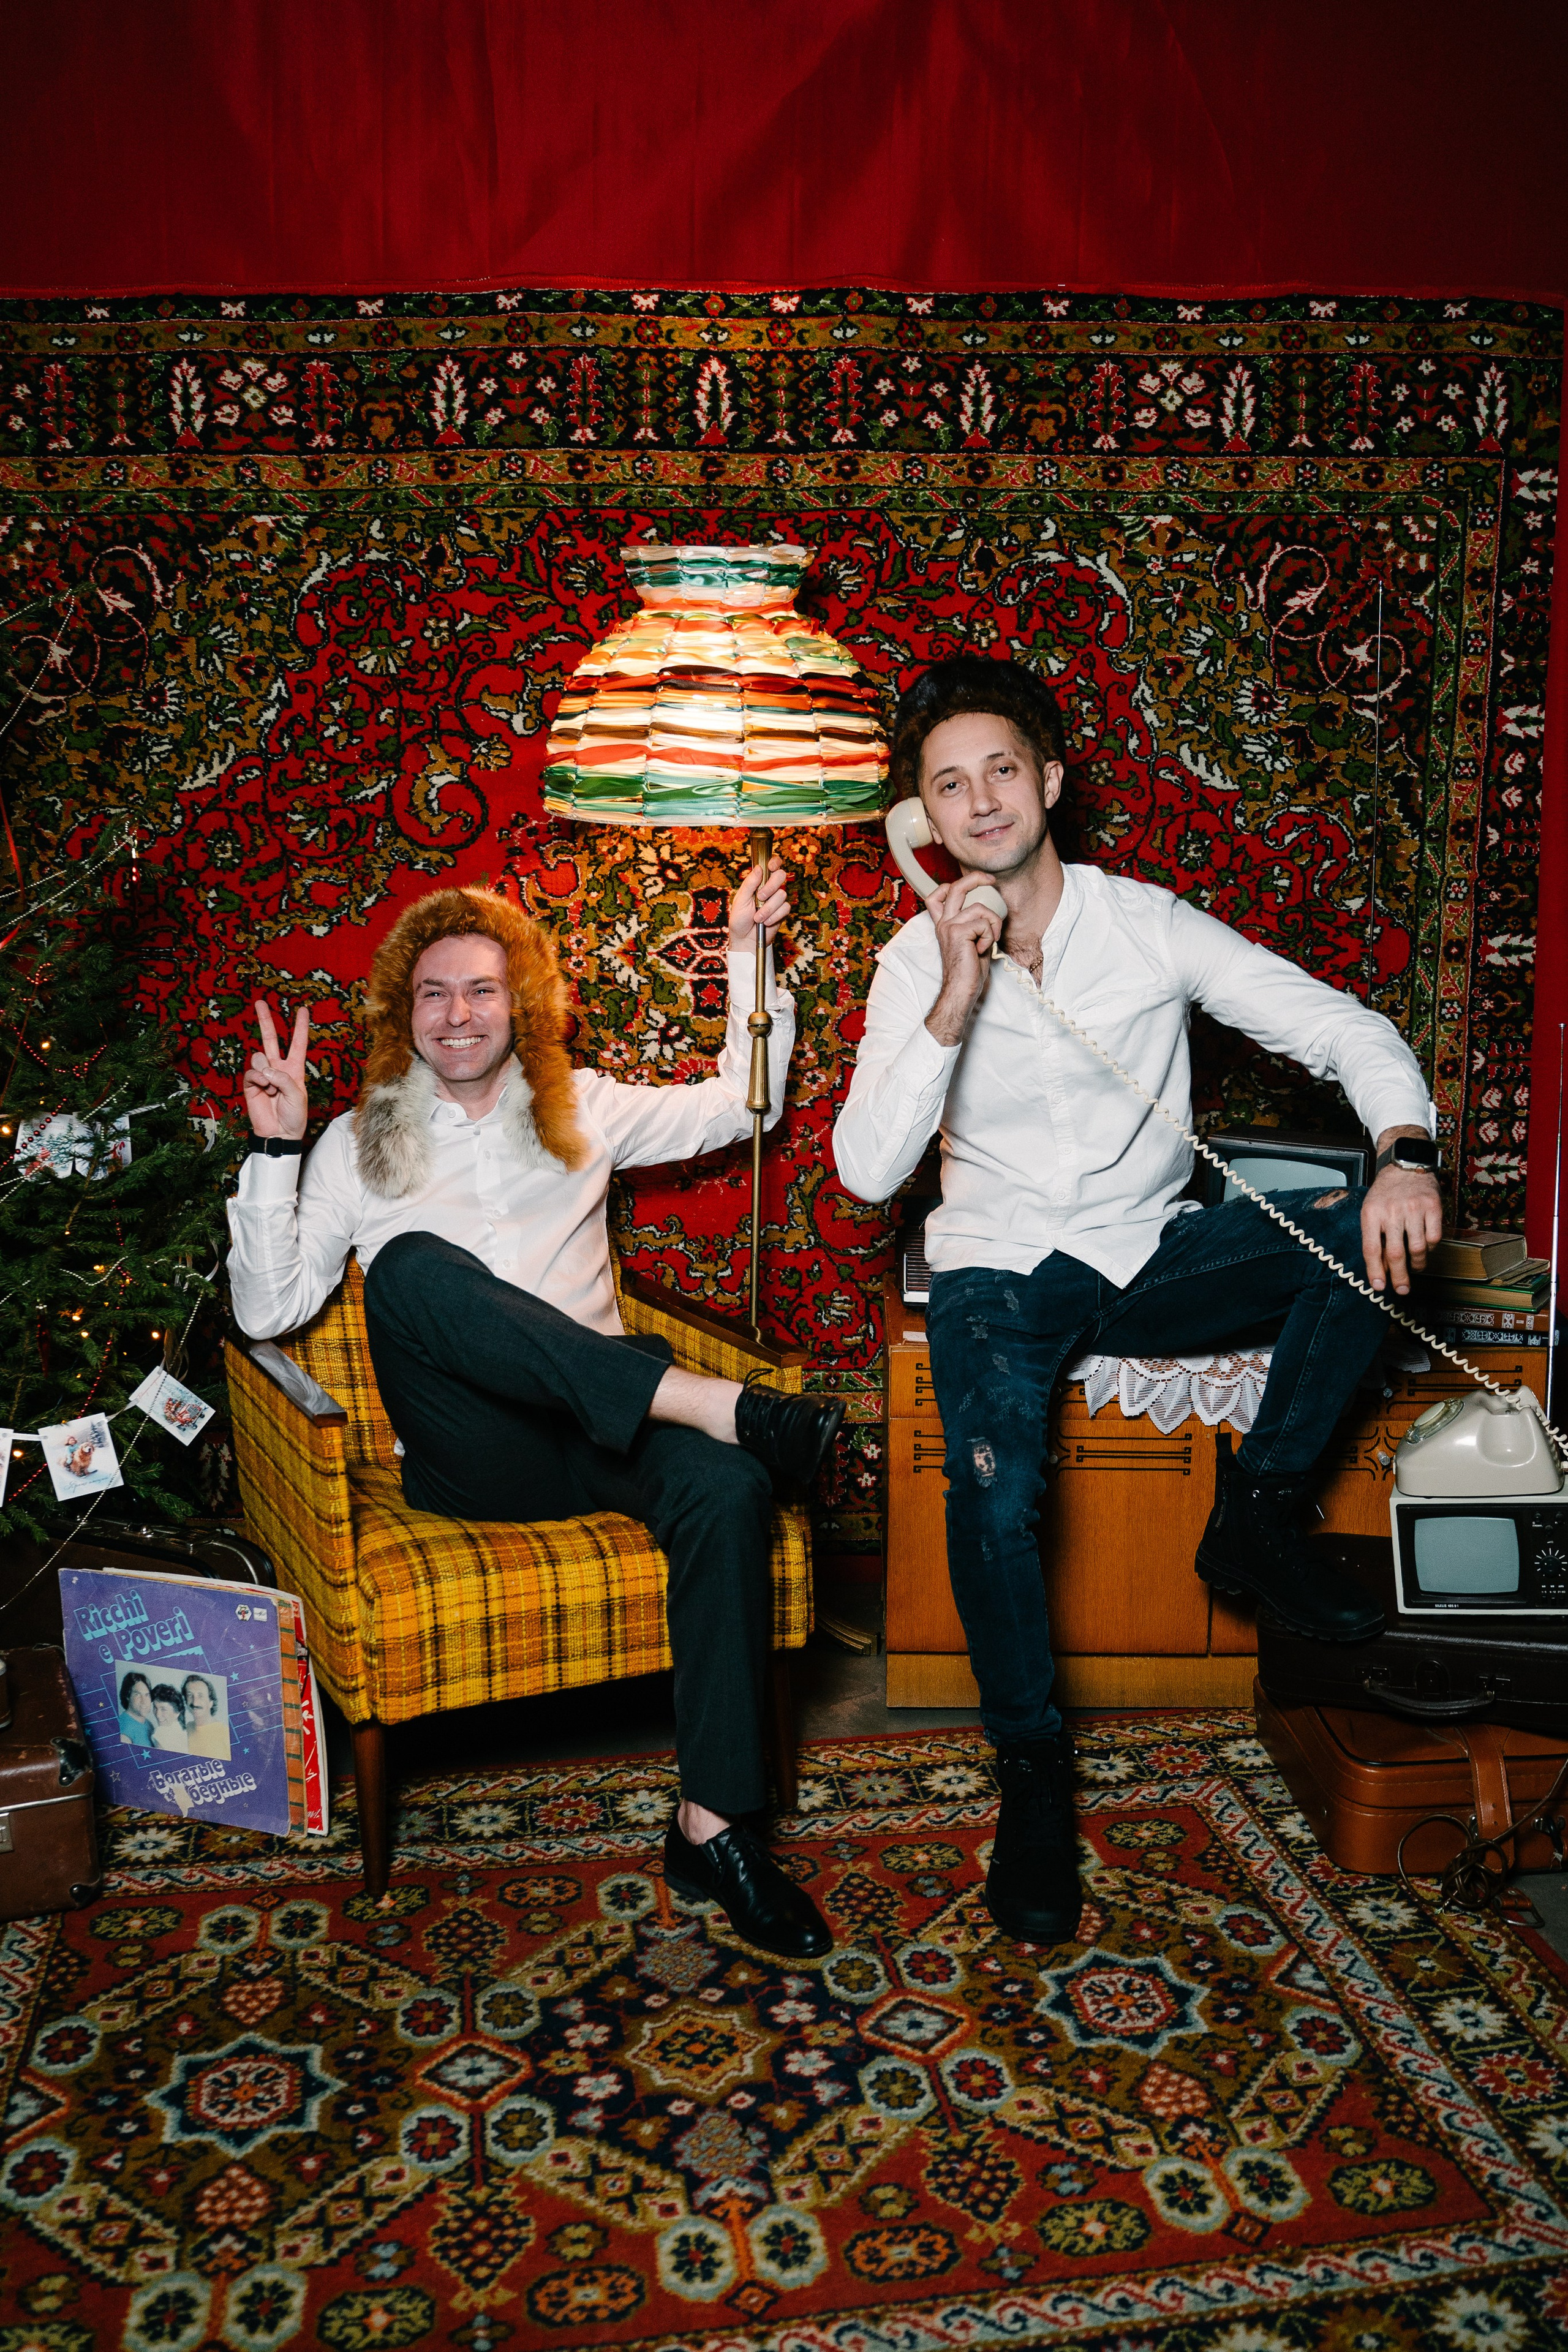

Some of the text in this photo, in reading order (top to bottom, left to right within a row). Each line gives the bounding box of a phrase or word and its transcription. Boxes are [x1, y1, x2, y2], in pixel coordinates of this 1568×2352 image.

[74, 1589, 149, 1642] Ricchi
[99, 1606, 195, 1664] e Poveri
[149, 1759, 226, 1794] Богатые
[187, 1772, 257, 1805] бедные
